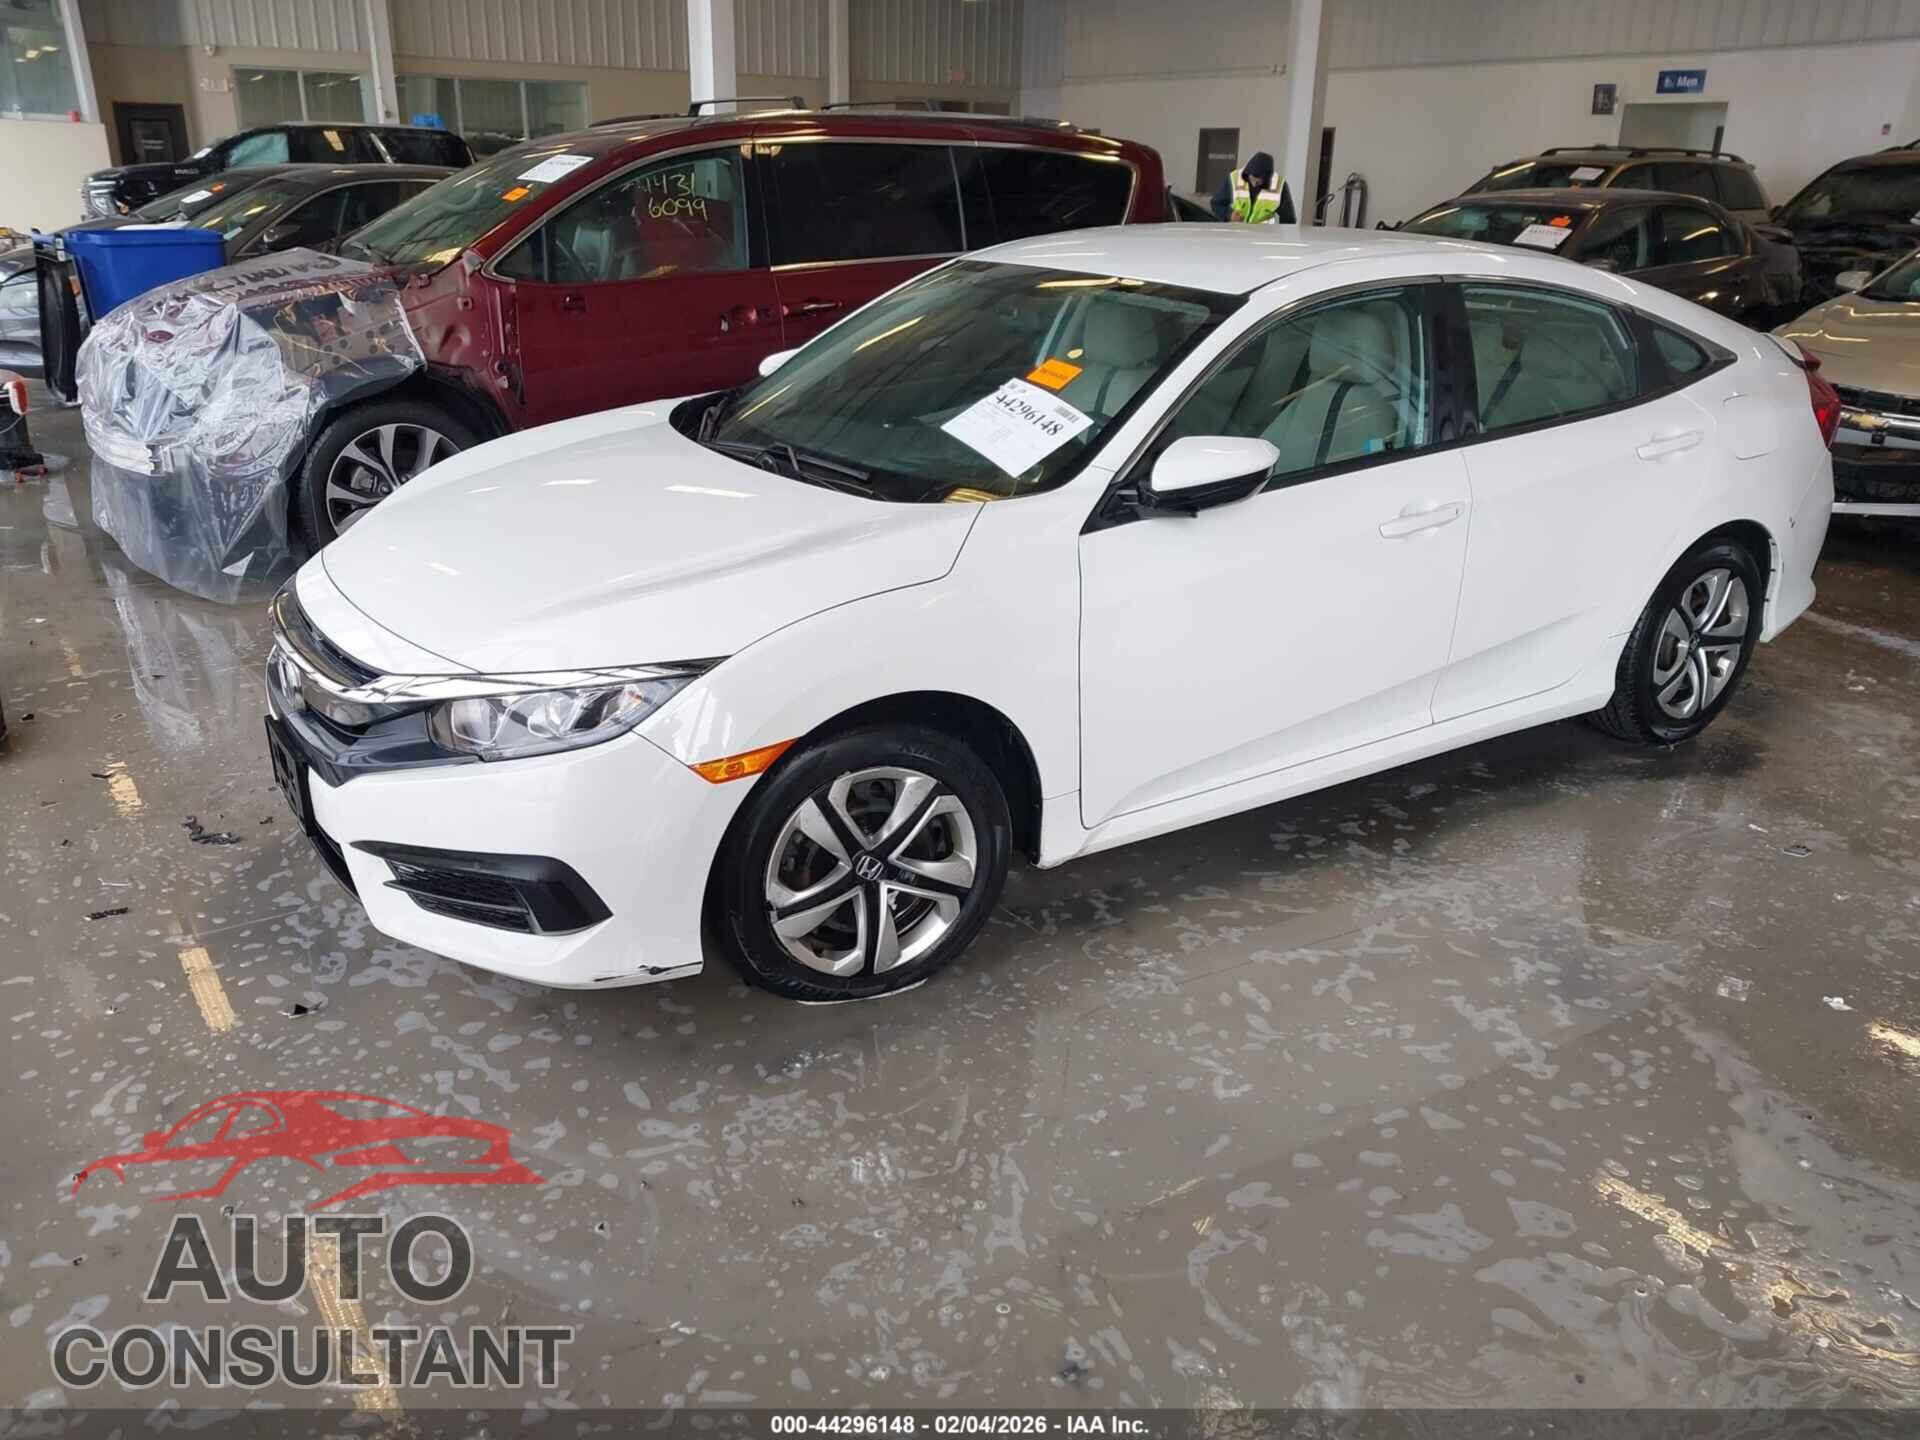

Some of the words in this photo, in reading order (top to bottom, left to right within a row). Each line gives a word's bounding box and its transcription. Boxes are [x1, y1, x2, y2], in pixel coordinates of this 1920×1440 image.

[1677, 75, 1698, 88] Men
[648, 197, 708, 221] 6099
[995, 393, 1065, 437] 44296148
